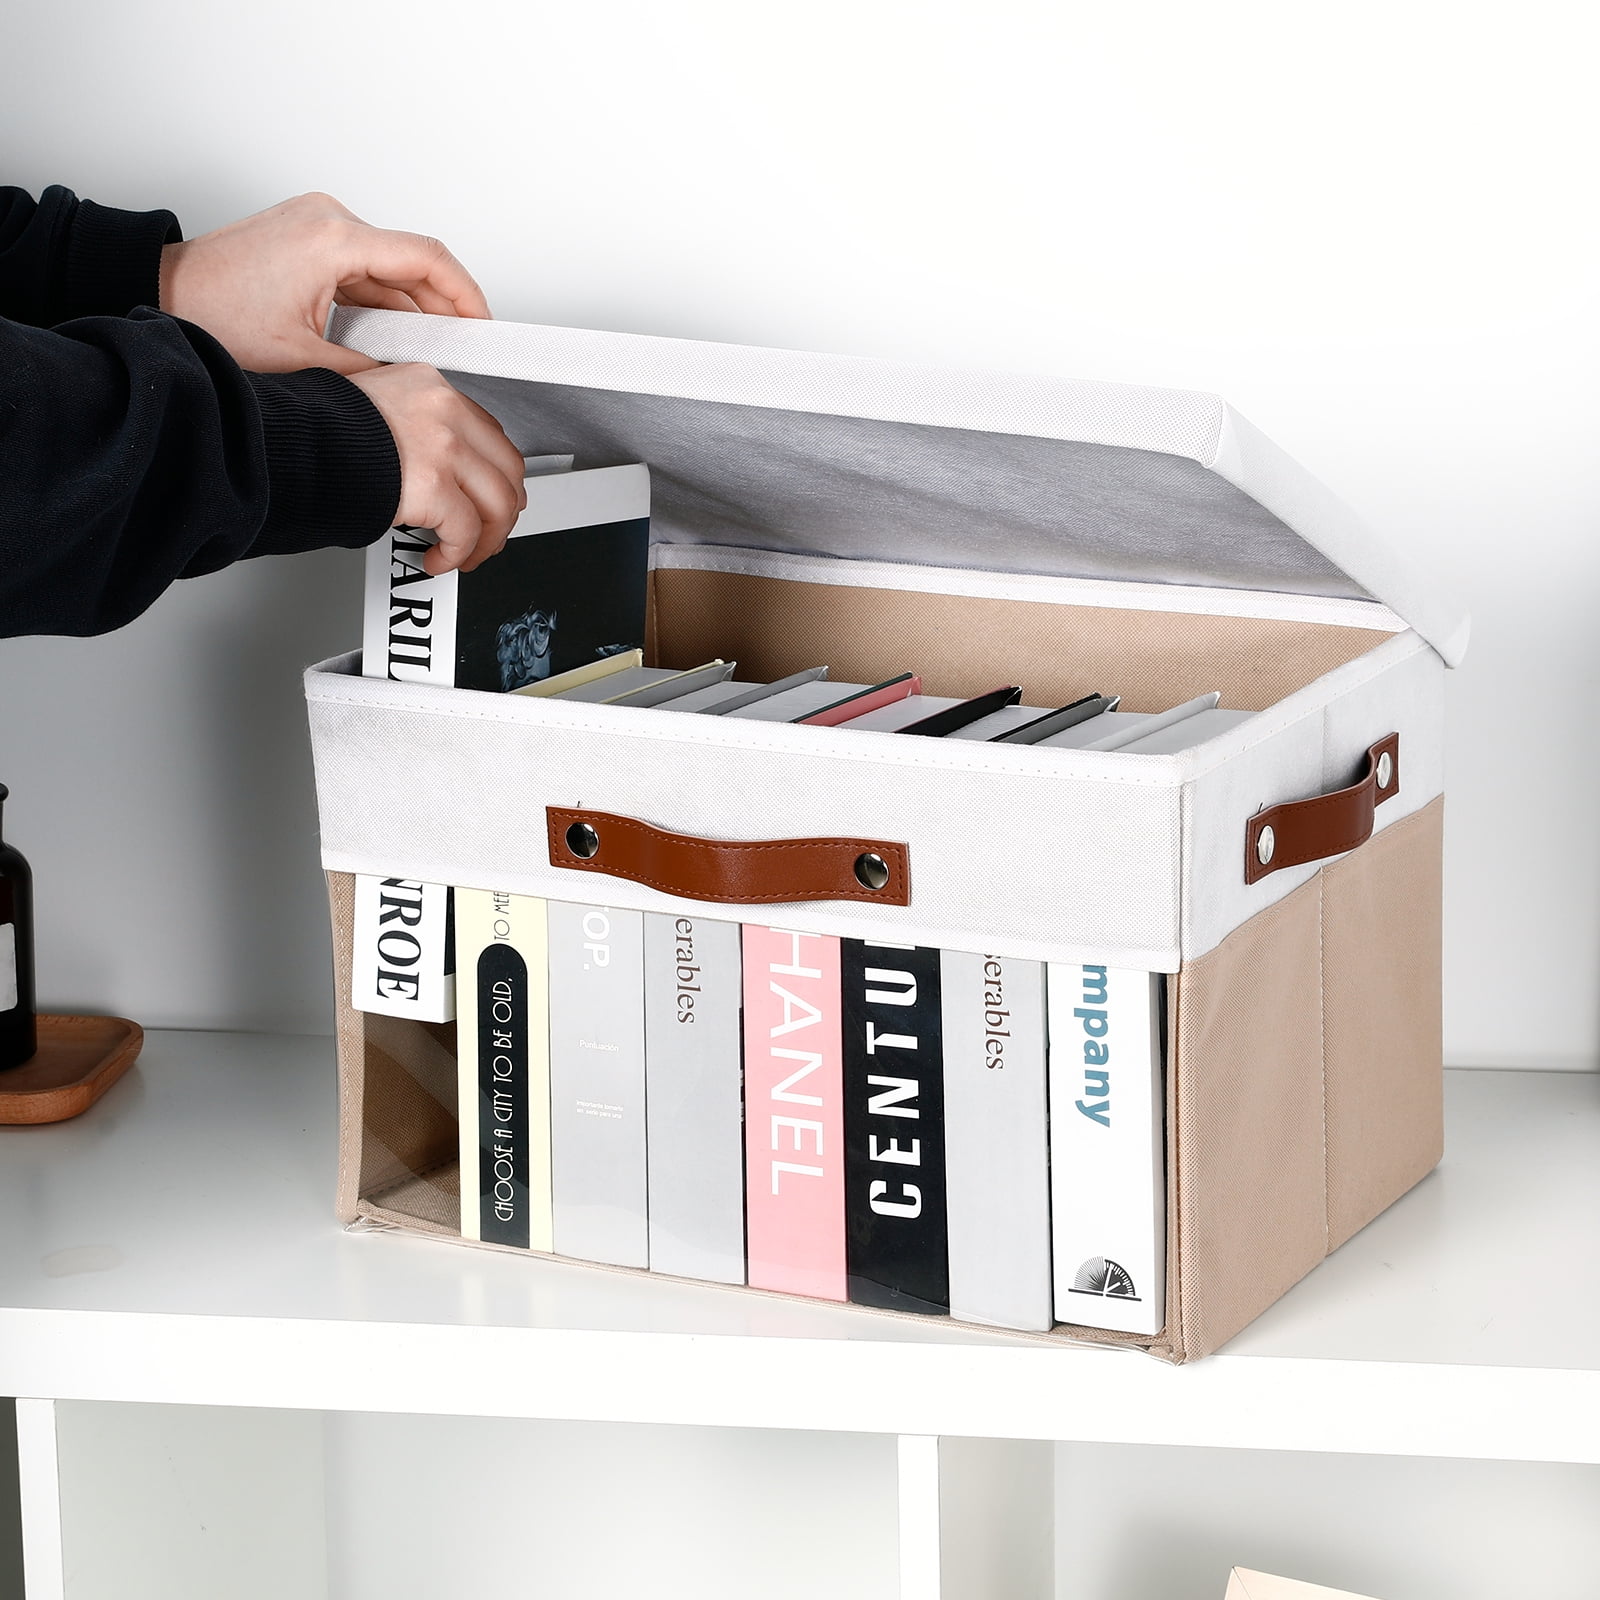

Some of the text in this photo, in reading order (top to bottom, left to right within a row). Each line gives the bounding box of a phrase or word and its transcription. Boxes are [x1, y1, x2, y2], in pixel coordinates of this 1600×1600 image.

[494, 919, 510, 940] TO
[582, 907, 610, 970] OP.
[492, 977, 513, 1023] OLD,
[675, 918, 701, 1023] erables
[493, 1029, 512, 1049] BE
[984, 954, 1011, 1070] erables
[493, 1055, 513, 1083] TO
[769, 927, 824, 1196] HANEL
[1074, 964, 1111, 1128] mpany
[493, 1089, 513, 1122] CITY
[864, 939, 922, 1219] CENTU
[494, 1128, 513, 1138] A
[494, 1145, 514, 1222] CHOOSE
